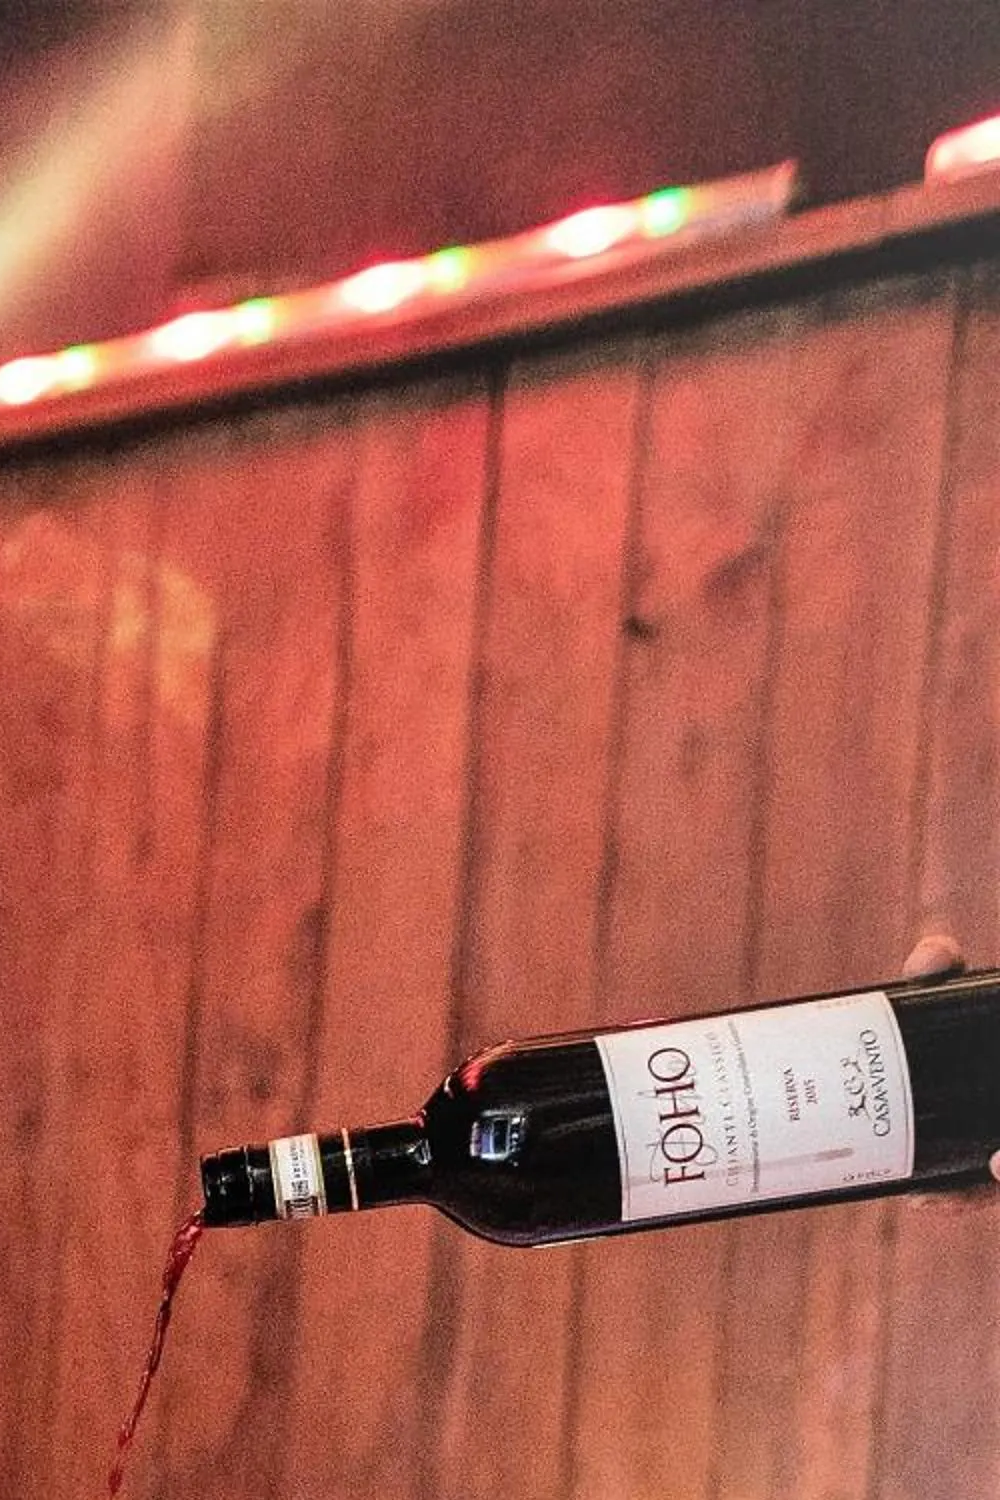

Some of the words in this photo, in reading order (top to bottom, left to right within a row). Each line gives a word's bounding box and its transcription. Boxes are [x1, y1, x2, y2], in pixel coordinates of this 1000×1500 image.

[647, 1047, 706, 1187] FOHO
[783, 1065, 801, 1122] RISERVA
[803, 1079, 818, 1105] 2015
